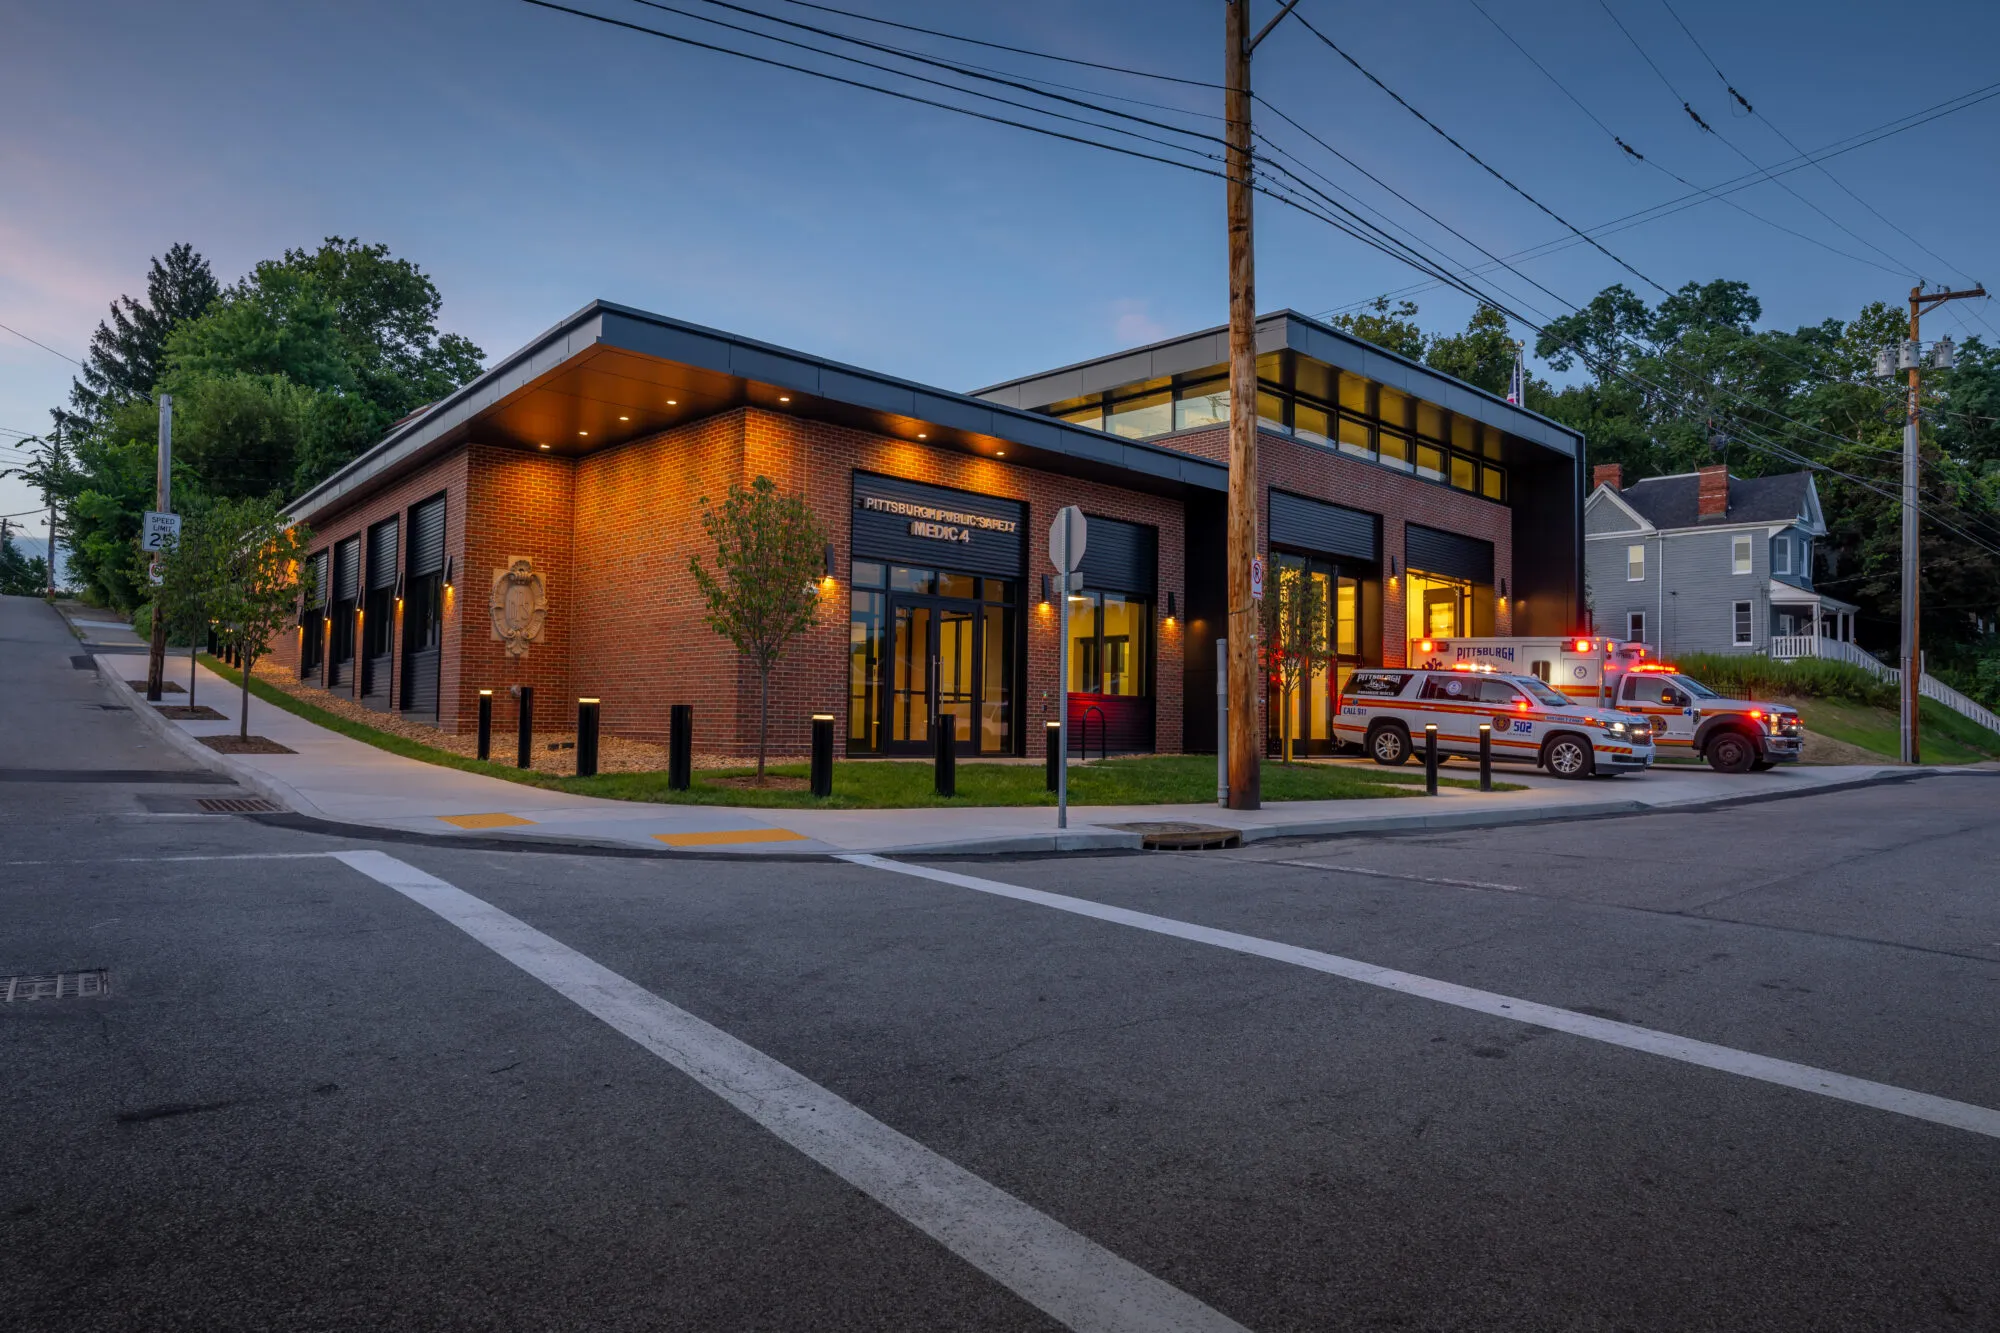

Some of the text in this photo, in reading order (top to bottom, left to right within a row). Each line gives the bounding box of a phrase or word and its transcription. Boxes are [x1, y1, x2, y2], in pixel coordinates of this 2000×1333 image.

[152, 517, 175, 525] SPEED
[865, 497, 1017, 533] PITTSBURGH PUBLIC SAFETY
[911, 521, 970, 543] MEDIC 4
[149, 533, 173, 547] 25
[1456, 647, 1515, 663] PITTSBURGH
[1356, 673, 1401, 685] PITTSBURGH
[1343, 707, 1367, 716] CALL 911
[1683, 707, 1693, 717] 4
[1513, 720, 1533, 734] 502
